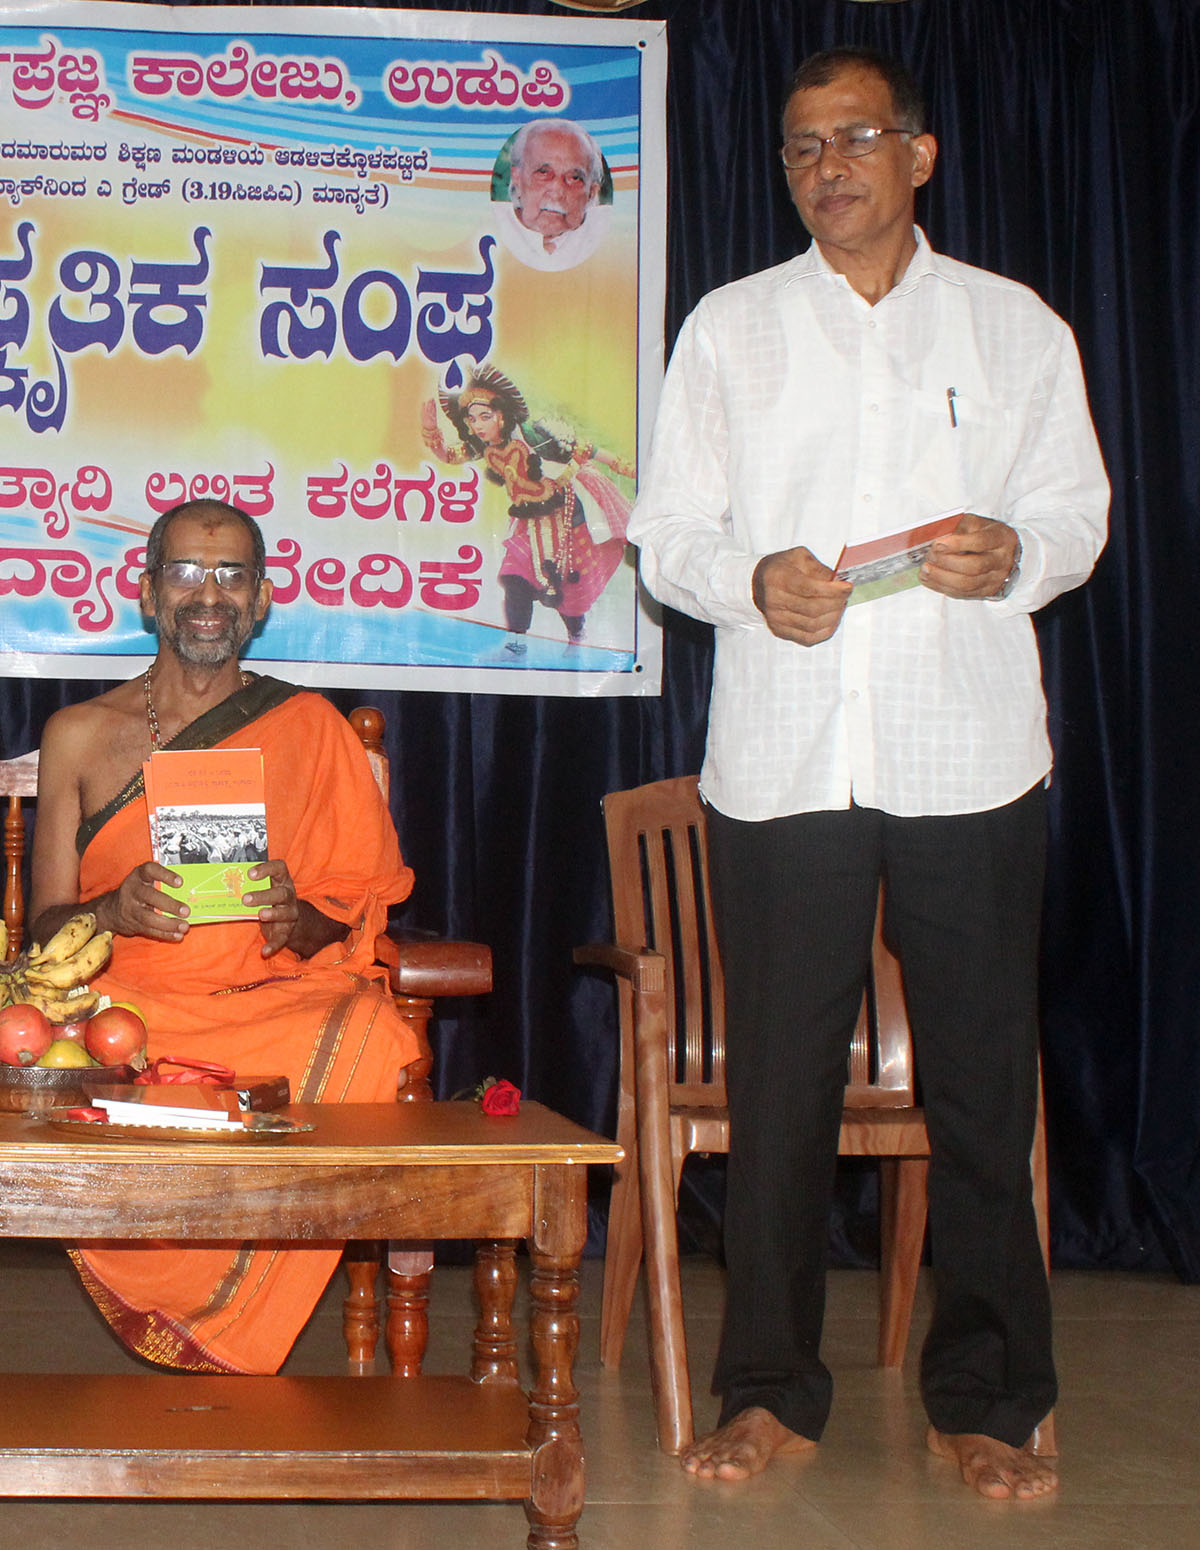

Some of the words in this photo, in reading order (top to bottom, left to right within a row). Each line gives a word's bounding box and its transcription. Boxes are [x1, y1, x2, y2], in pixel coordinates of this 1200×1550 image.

[132, 46, 356, 108] ಕಾಲೇಜು,
[389, 54, 564, 107] ಉಡುಪಿ
[118, 141, 161, 171] ಶಿಕ್ಷಣ
[172, 144, 264, 166] ಮಂಡಳಿಯ
[275, 146, 428, 180] ಆಡಳಿತಕ್ಕೊಳಪಟ್ಟಿದೆ
[122, 177, 171, 205] ಗ್ರೇಡ್
[313, 182, 389, 214] ಮಾನ್ಯತೆ)
[260, 230, 497, 389] ಸಂಘ
[145, 460, 275, 517] ಲಲಿತ
[306, 462, 479, 523] ಕಲೆಗಳ
